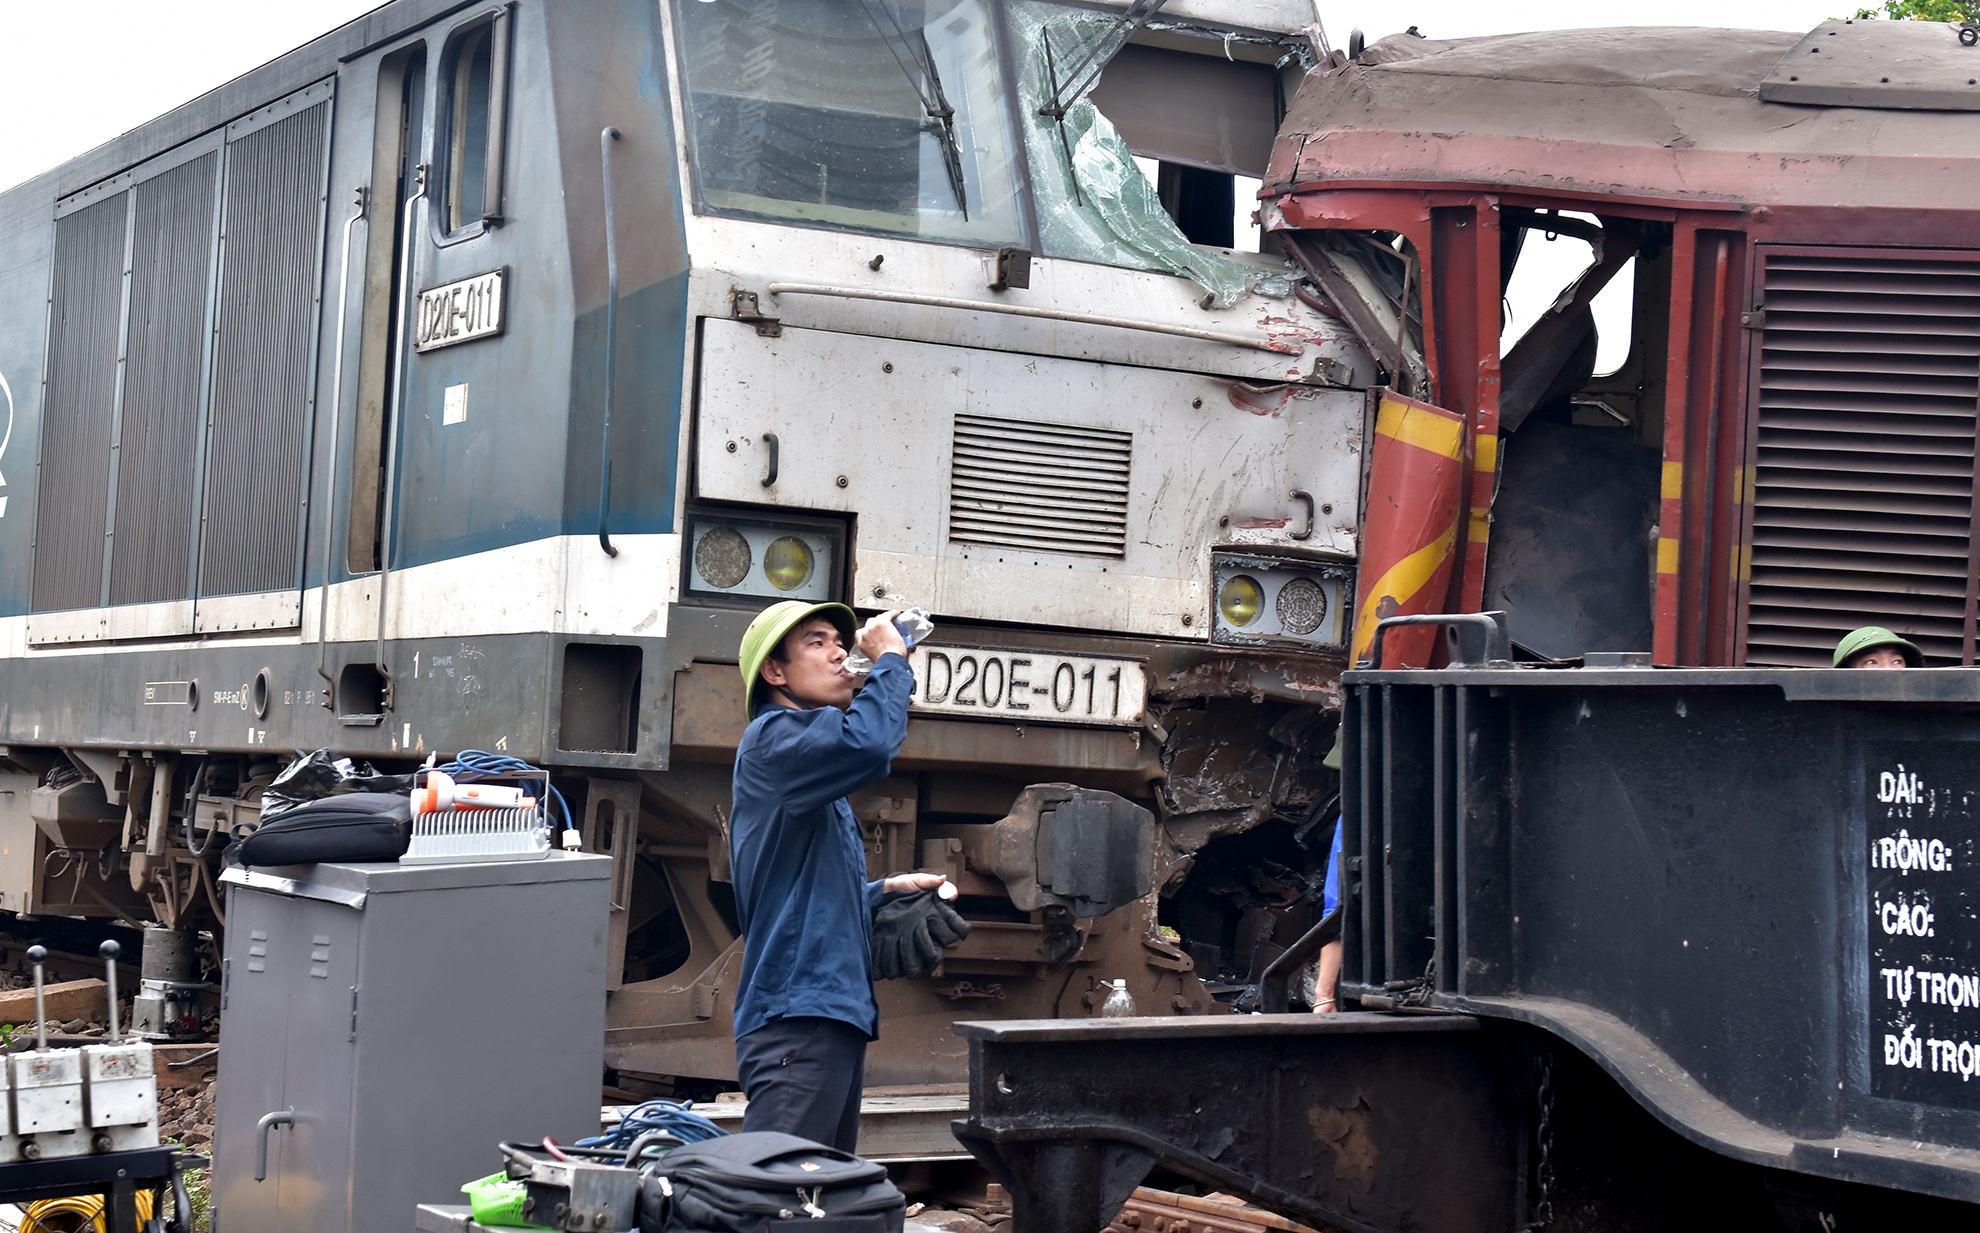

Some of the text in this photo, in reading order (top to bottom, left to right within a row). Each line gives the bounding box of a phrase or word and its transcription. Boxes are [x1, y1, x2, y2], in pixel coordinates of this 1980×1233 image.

[422, 278, 494, 343] D20E-011
[924, 651, 1121, 716] D20E-011
[1880, 763, 1923, 804] DÀI:
[1880, 828, 1952, 876] RỘNG:
[1881, 902, 1935, 937] CAO:
[1881, 965, 1980, 1013] TỰ TRỌN
